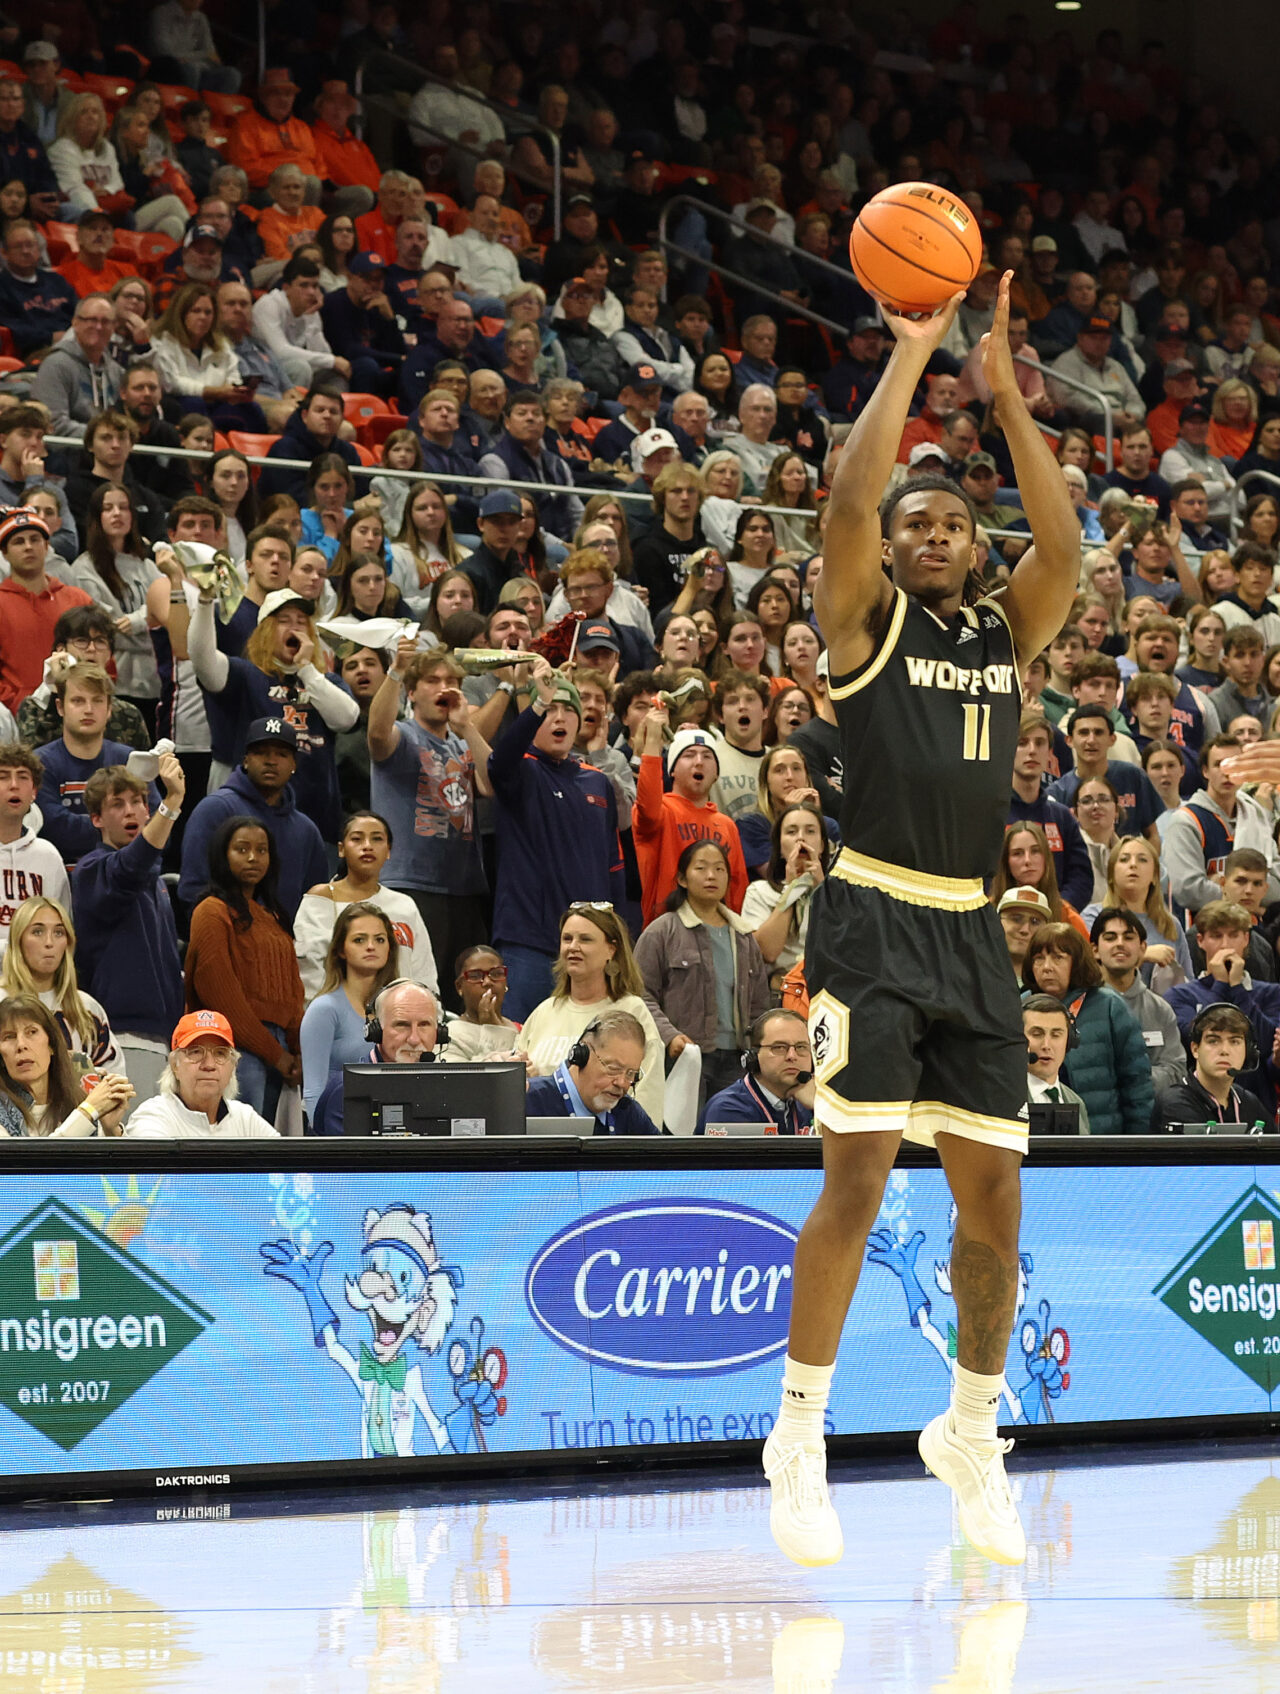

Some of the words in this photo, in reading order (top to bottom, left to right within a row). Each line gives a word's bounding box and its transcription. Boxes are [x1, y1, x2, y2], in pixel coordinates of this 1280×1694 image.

[908, 187, 969, 227] ELITE
[265, 719, 282, 733] NY
[961, 703, 991, 761] 11
[722, 774, 758, 792] AUB
[2, 869, 43, 900] URN
[574, 1248, 792, 1320] Carrier
[0, 1308, 168, 1362] nsigreen
[1234, 1337, 1261, 1356] est.
[18, 1382, 55, 1405] est.
[60, 1380, 111, 1403] 2007
[541, 1410, 616, 1451] Turn
[624, 1410, 656, 1446] to
[664, 1404, 714, 1444] the
[155, 1473, 231, 1488] DAKTRONICS
